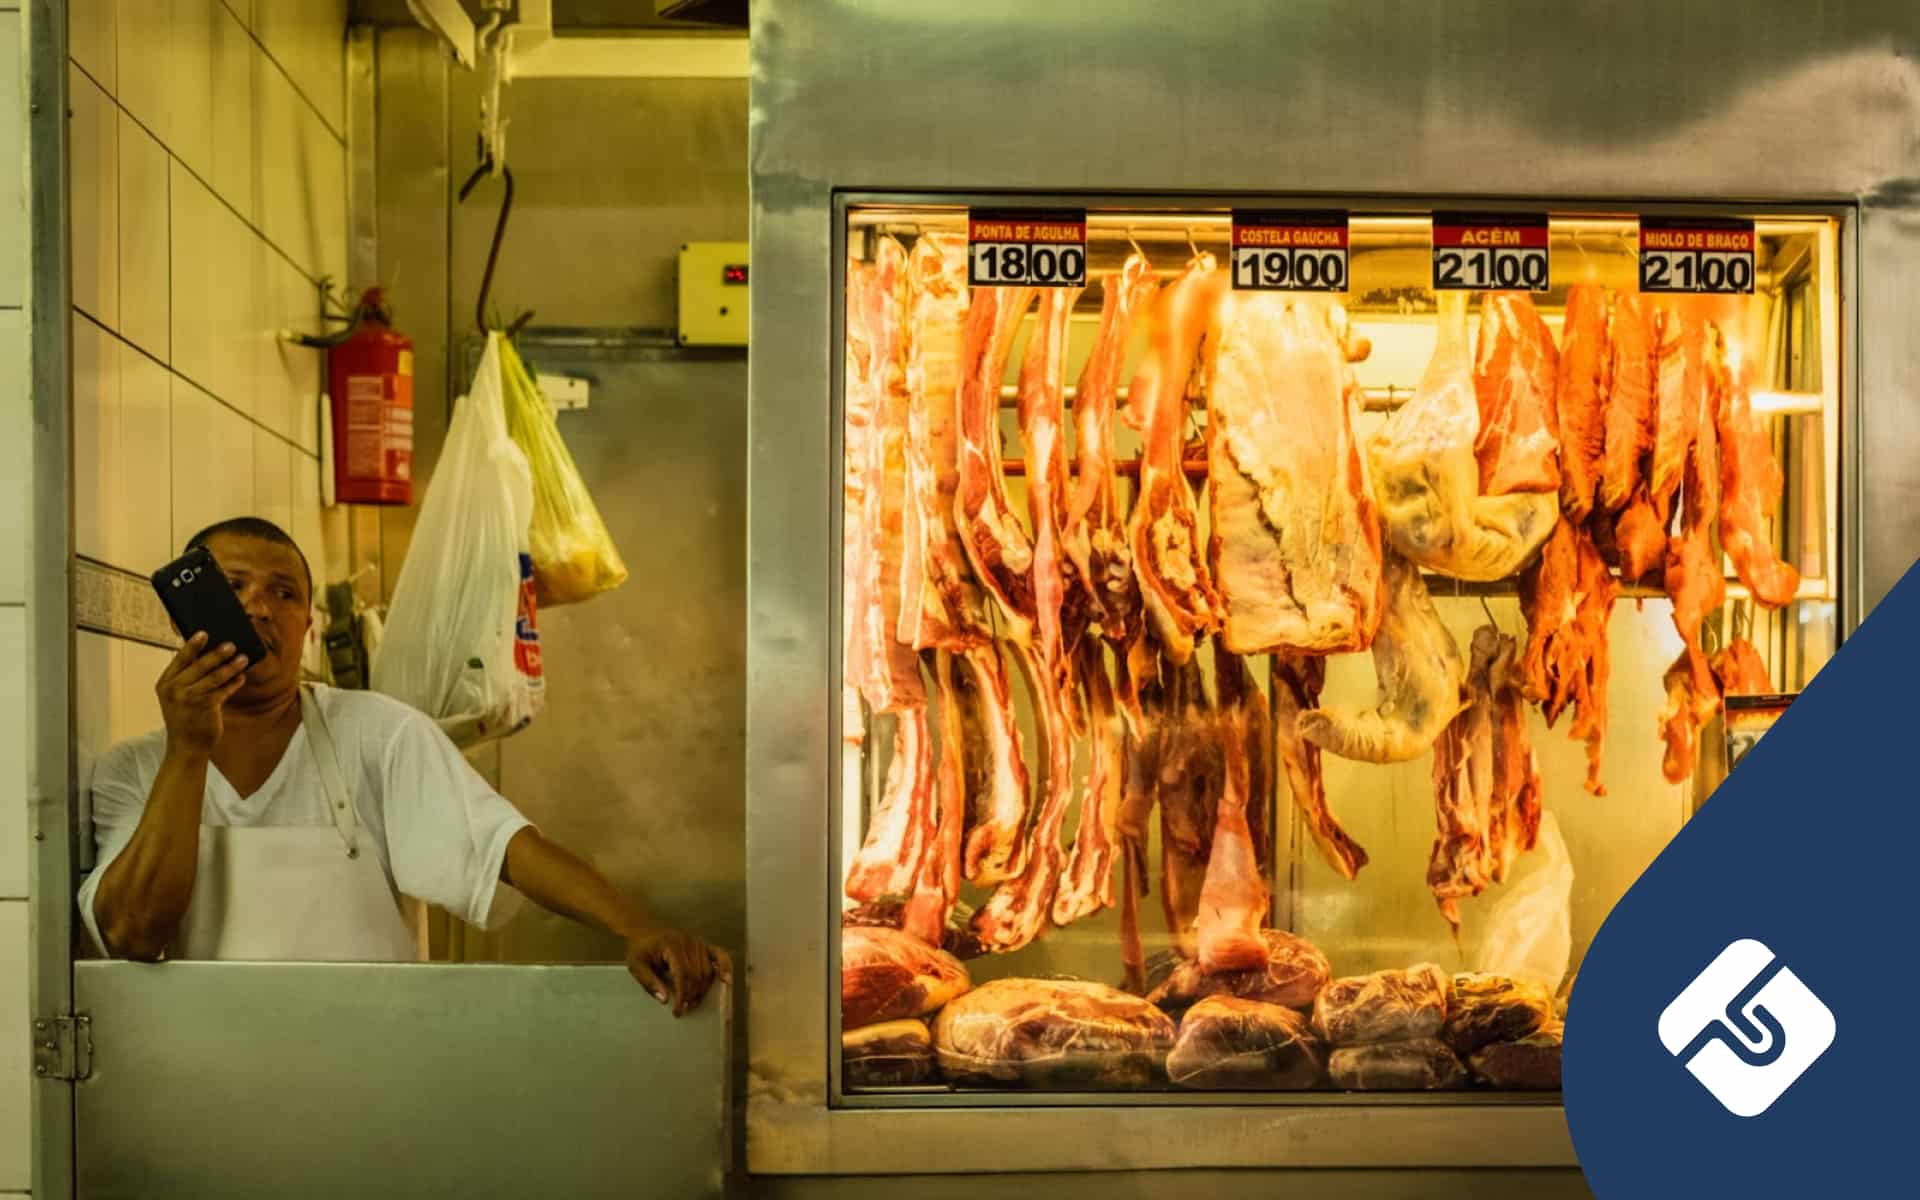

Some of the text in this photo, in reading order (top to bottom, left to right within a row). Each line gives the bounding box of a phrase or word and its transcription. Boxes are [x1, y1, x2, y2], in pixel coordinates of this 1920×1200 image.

[975, 224, 1080, 240] PONTA DE AGULHA
[1240, 229, 1290, 243] COSTELA
[1645, 232, 1750, 250] MIOLO DE BRAÇO
